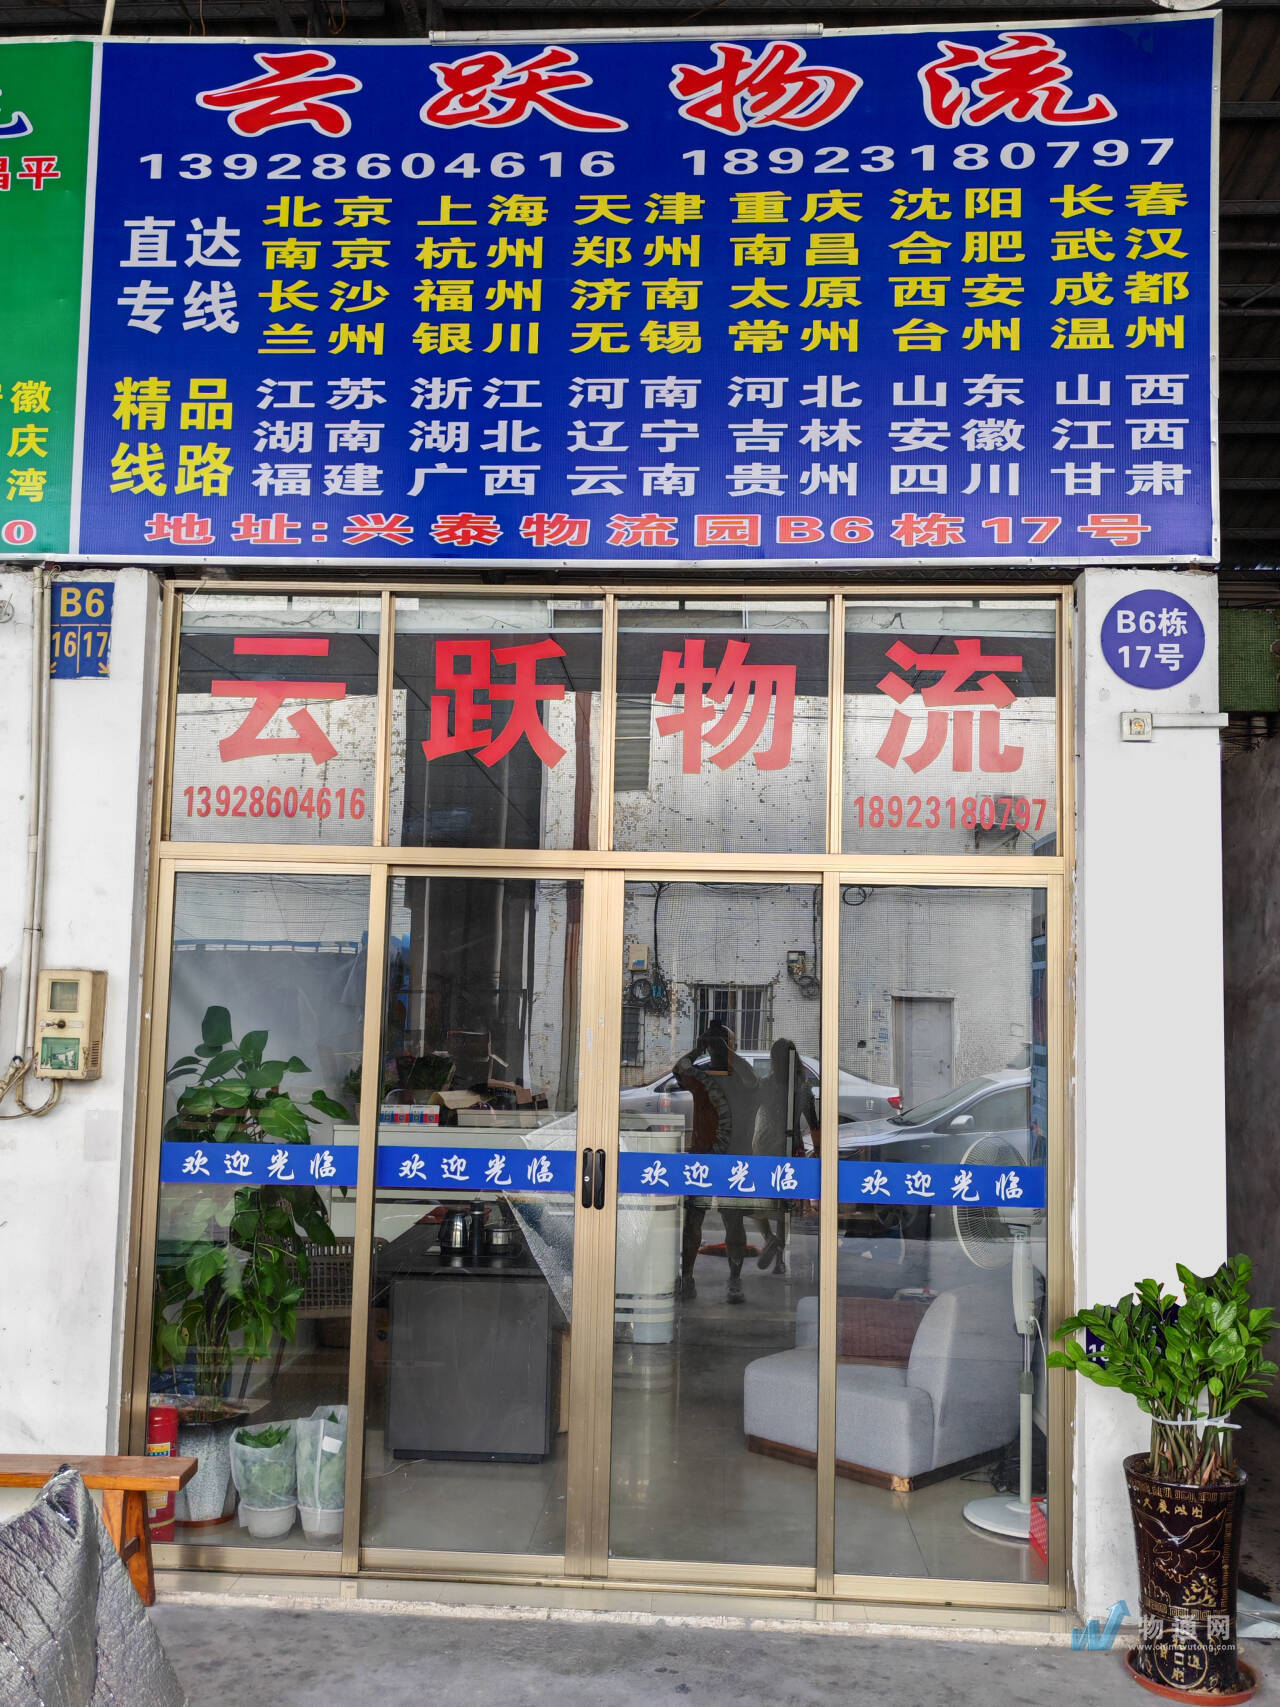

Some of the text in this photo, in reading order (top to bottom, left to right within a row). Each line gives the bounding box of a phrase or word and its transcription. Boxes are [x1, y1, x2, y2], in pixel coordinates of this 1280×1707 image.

[196, 32, 1118, 136] 云跃物流
[139, 138, 1173, 180] 13928604616 18923180797
[264, 182, 1188, 227] 北京 上海 天津 重庆 沈阳 长春
[120, 216, 240, 267] 直达
[262, 228, 1187, 269] 南京 杭州 郑州 南昌 合肥 武汉
[118, 280, 239, 333] 专线
[259, 271, 1189, 312] 长沙 福州 济南 太原 西安 成都
[259, 315, 1184, 354] 兰州 银川 无锡 常州 台州 温州
[0, 379, 52, 415] 徽
[114, 377, 232, 430] 精品
[257, 374, 1189, 409] 江苏 浙江 河南 河北 山东 山西
[255, 418, 1189, 453] 湖南 湖北 辽宁 吉林 安徽 江西
[111, 443, 233, 496] 线路
[252, 461, 1191, 496] 福建 广西 云南 贵州 四川 甘肃
[62, 588, 104, 617] B6
[1117, 608, 1188, 636] B6栋
[53, 632, 107, 657] 16 17
[1112, 644, 1184, 674] 17号
[212, 637, 1022, 773] 云跃物流
[185, 786, 364, 819] 13928604616
[855, 795, 1046, 830] 18923180797
[183, 1150, 336, 1180] 欢迎光临
[399, 1154, 553, 1184] 欢迎光临
[641, 1161, 797, 1192] 欢迎光临
[862, 1170, 1022, 1201] 欢迎光临
